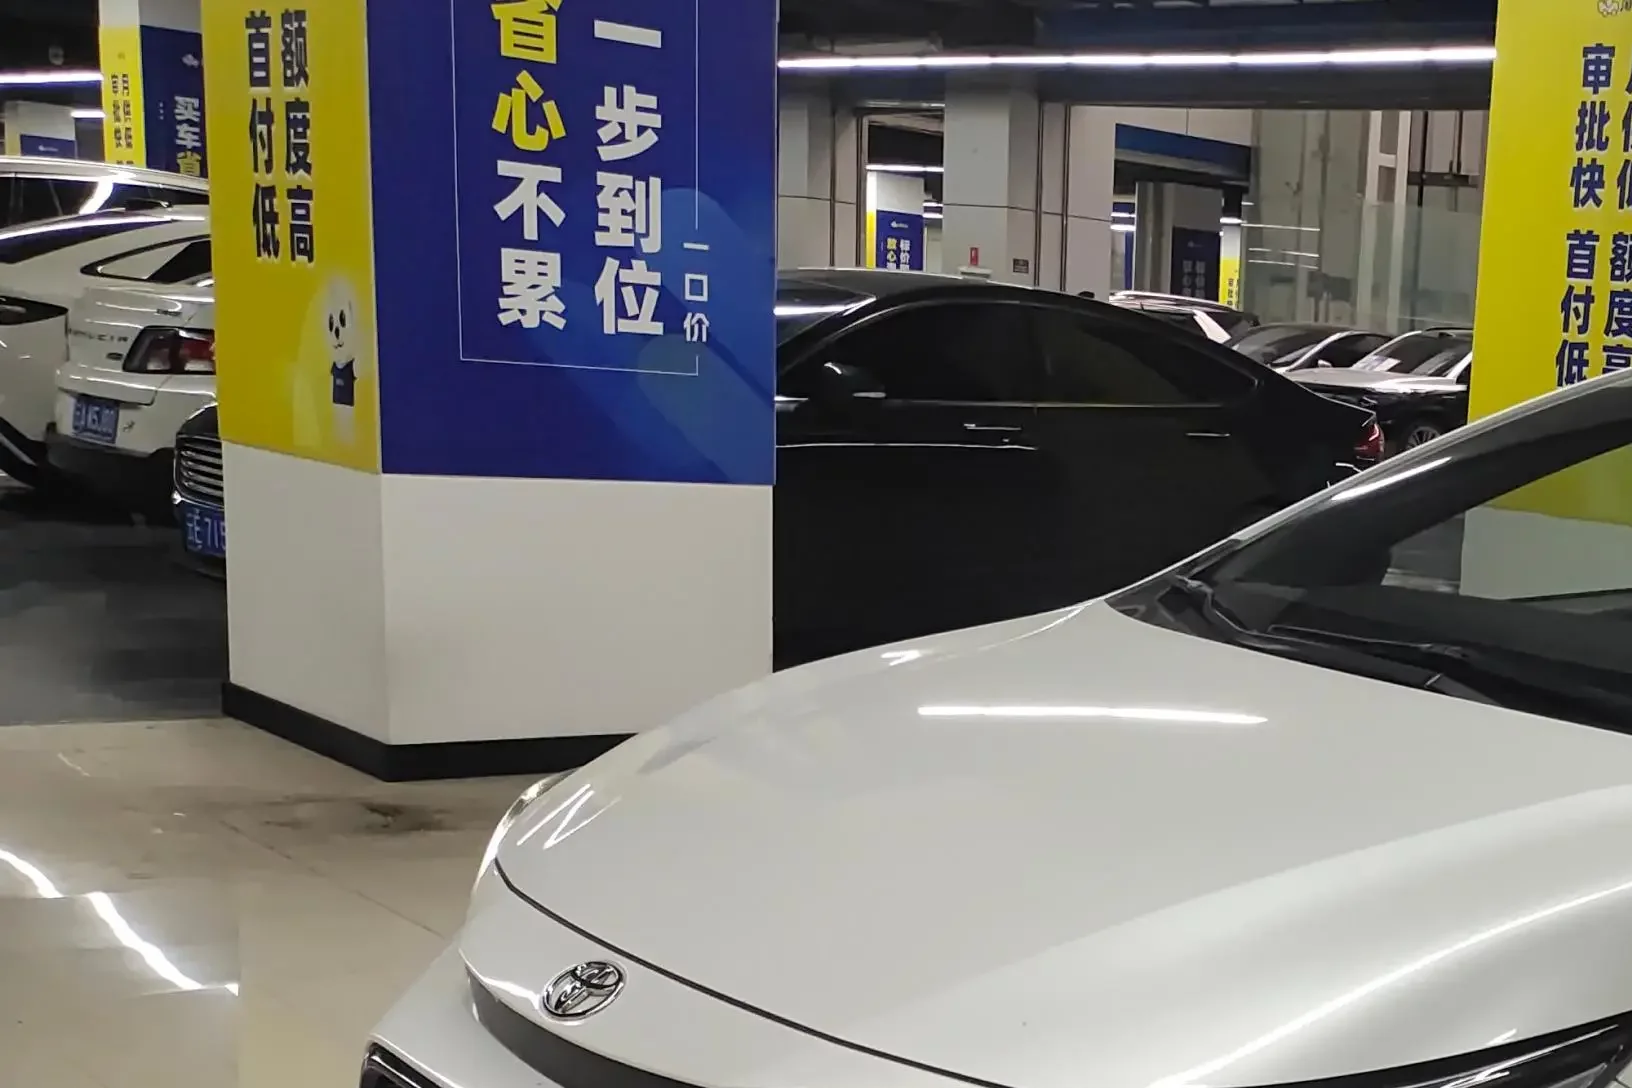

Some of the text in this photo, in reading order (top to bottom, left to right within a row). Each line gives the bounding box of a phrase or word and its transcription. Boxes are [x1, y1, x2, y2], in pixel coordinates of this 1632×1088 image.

[245, 10, 280, 259] 首付低
[281, 9, 315, 264] 额度高
[491, 0, 566, 330] 省心不累
[594, 19, 664, 336] 一步到位
[1555, 42, 1616, 387] 审批快 首付低
[683, 242, 710, 342] 一口价
